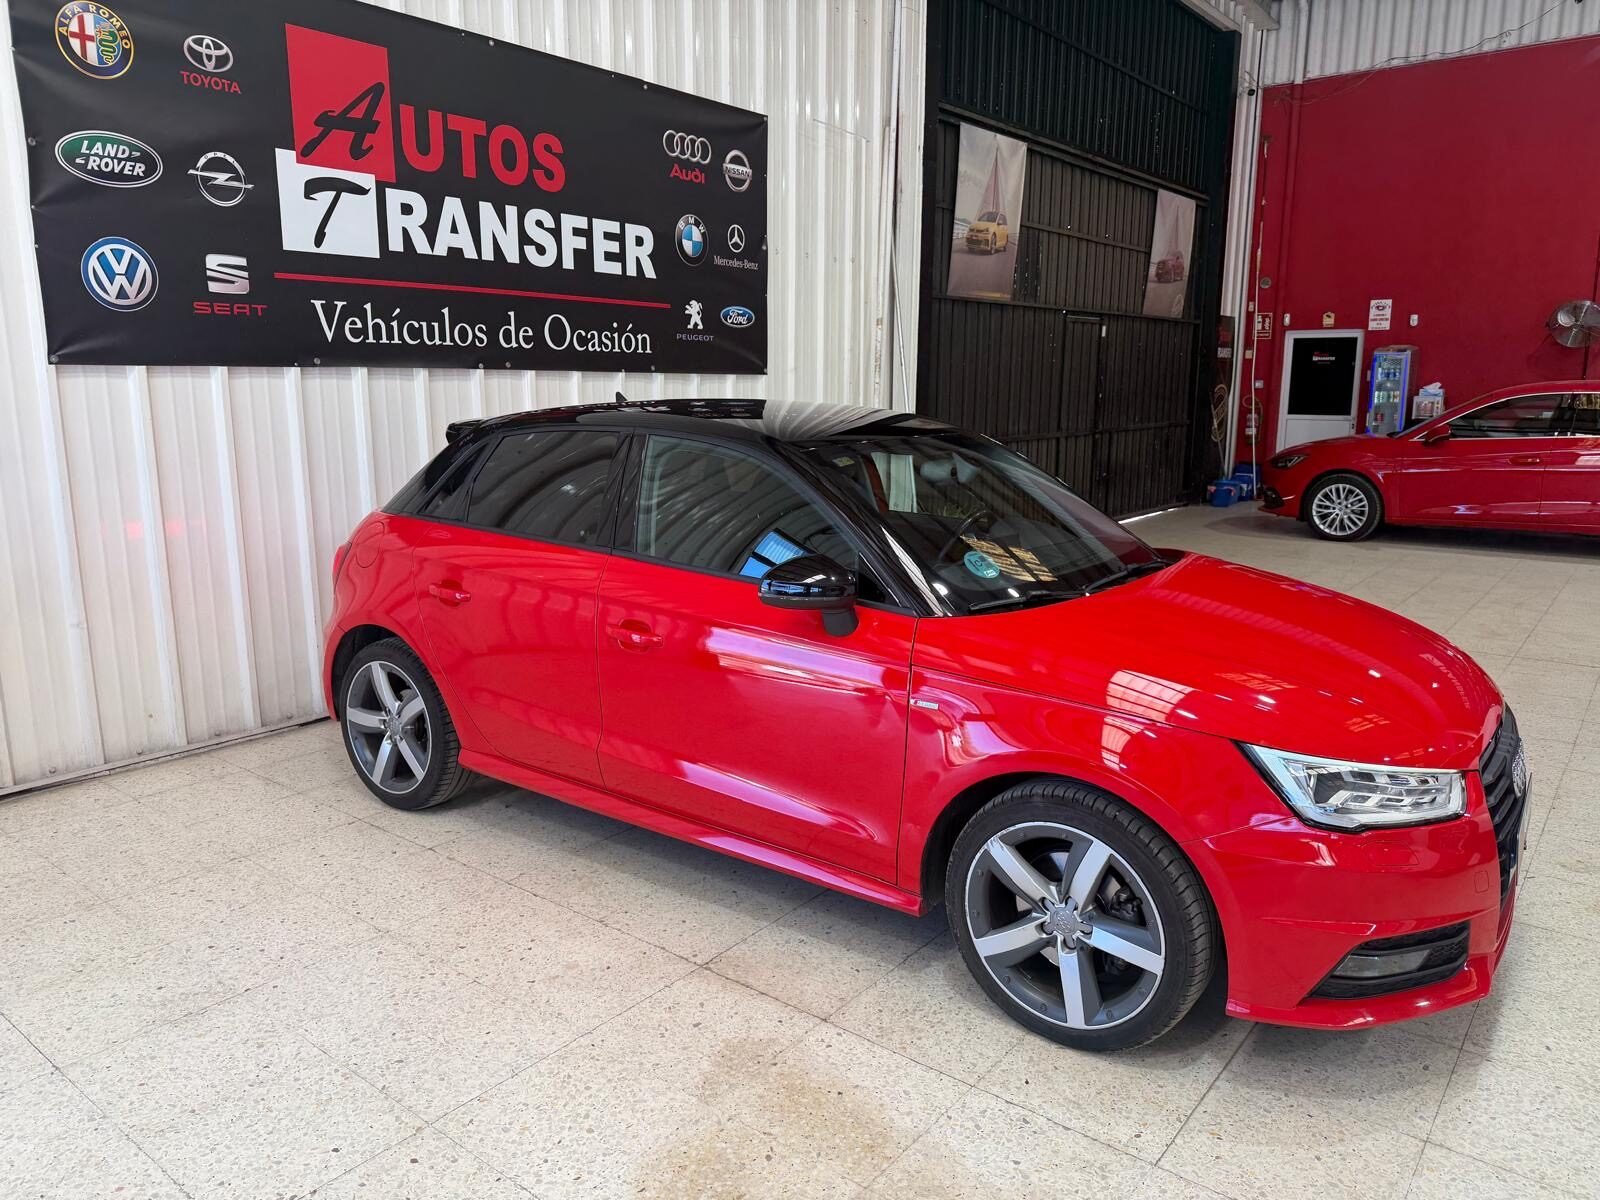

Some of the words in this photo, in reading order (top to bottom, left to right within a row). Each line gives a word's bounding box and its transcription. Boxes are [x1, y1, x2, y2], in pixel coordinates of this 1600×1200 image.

[59, 5, 82, 36] ALFA
[88, 4, 131, 49] ROMEO
[180, 71, 242, 94] TOYOTA
[300, 82, 567, 193] AUTOS
[80, 140, 132, 158] LAND
[87, 158, 146, 178] ROVER
[670, 163, 706, 185] Audi
[725, 165, 751, 178] NISSAN
[303, 176, 657, 280] TRANSFER
[679, 216, 706, 233] BMW
[713, 255, 759, 271] Mercedes-Benz
[192, 302, 267, 316] SEAT
[726, 309, 749, 325] Ford
[311, 299, 488, 348] Vehículos
[498, 311, 534, 349] de
[543, 313, 653, 354] Ocasión
[676, 332, 715, 342] PEUGEOT
